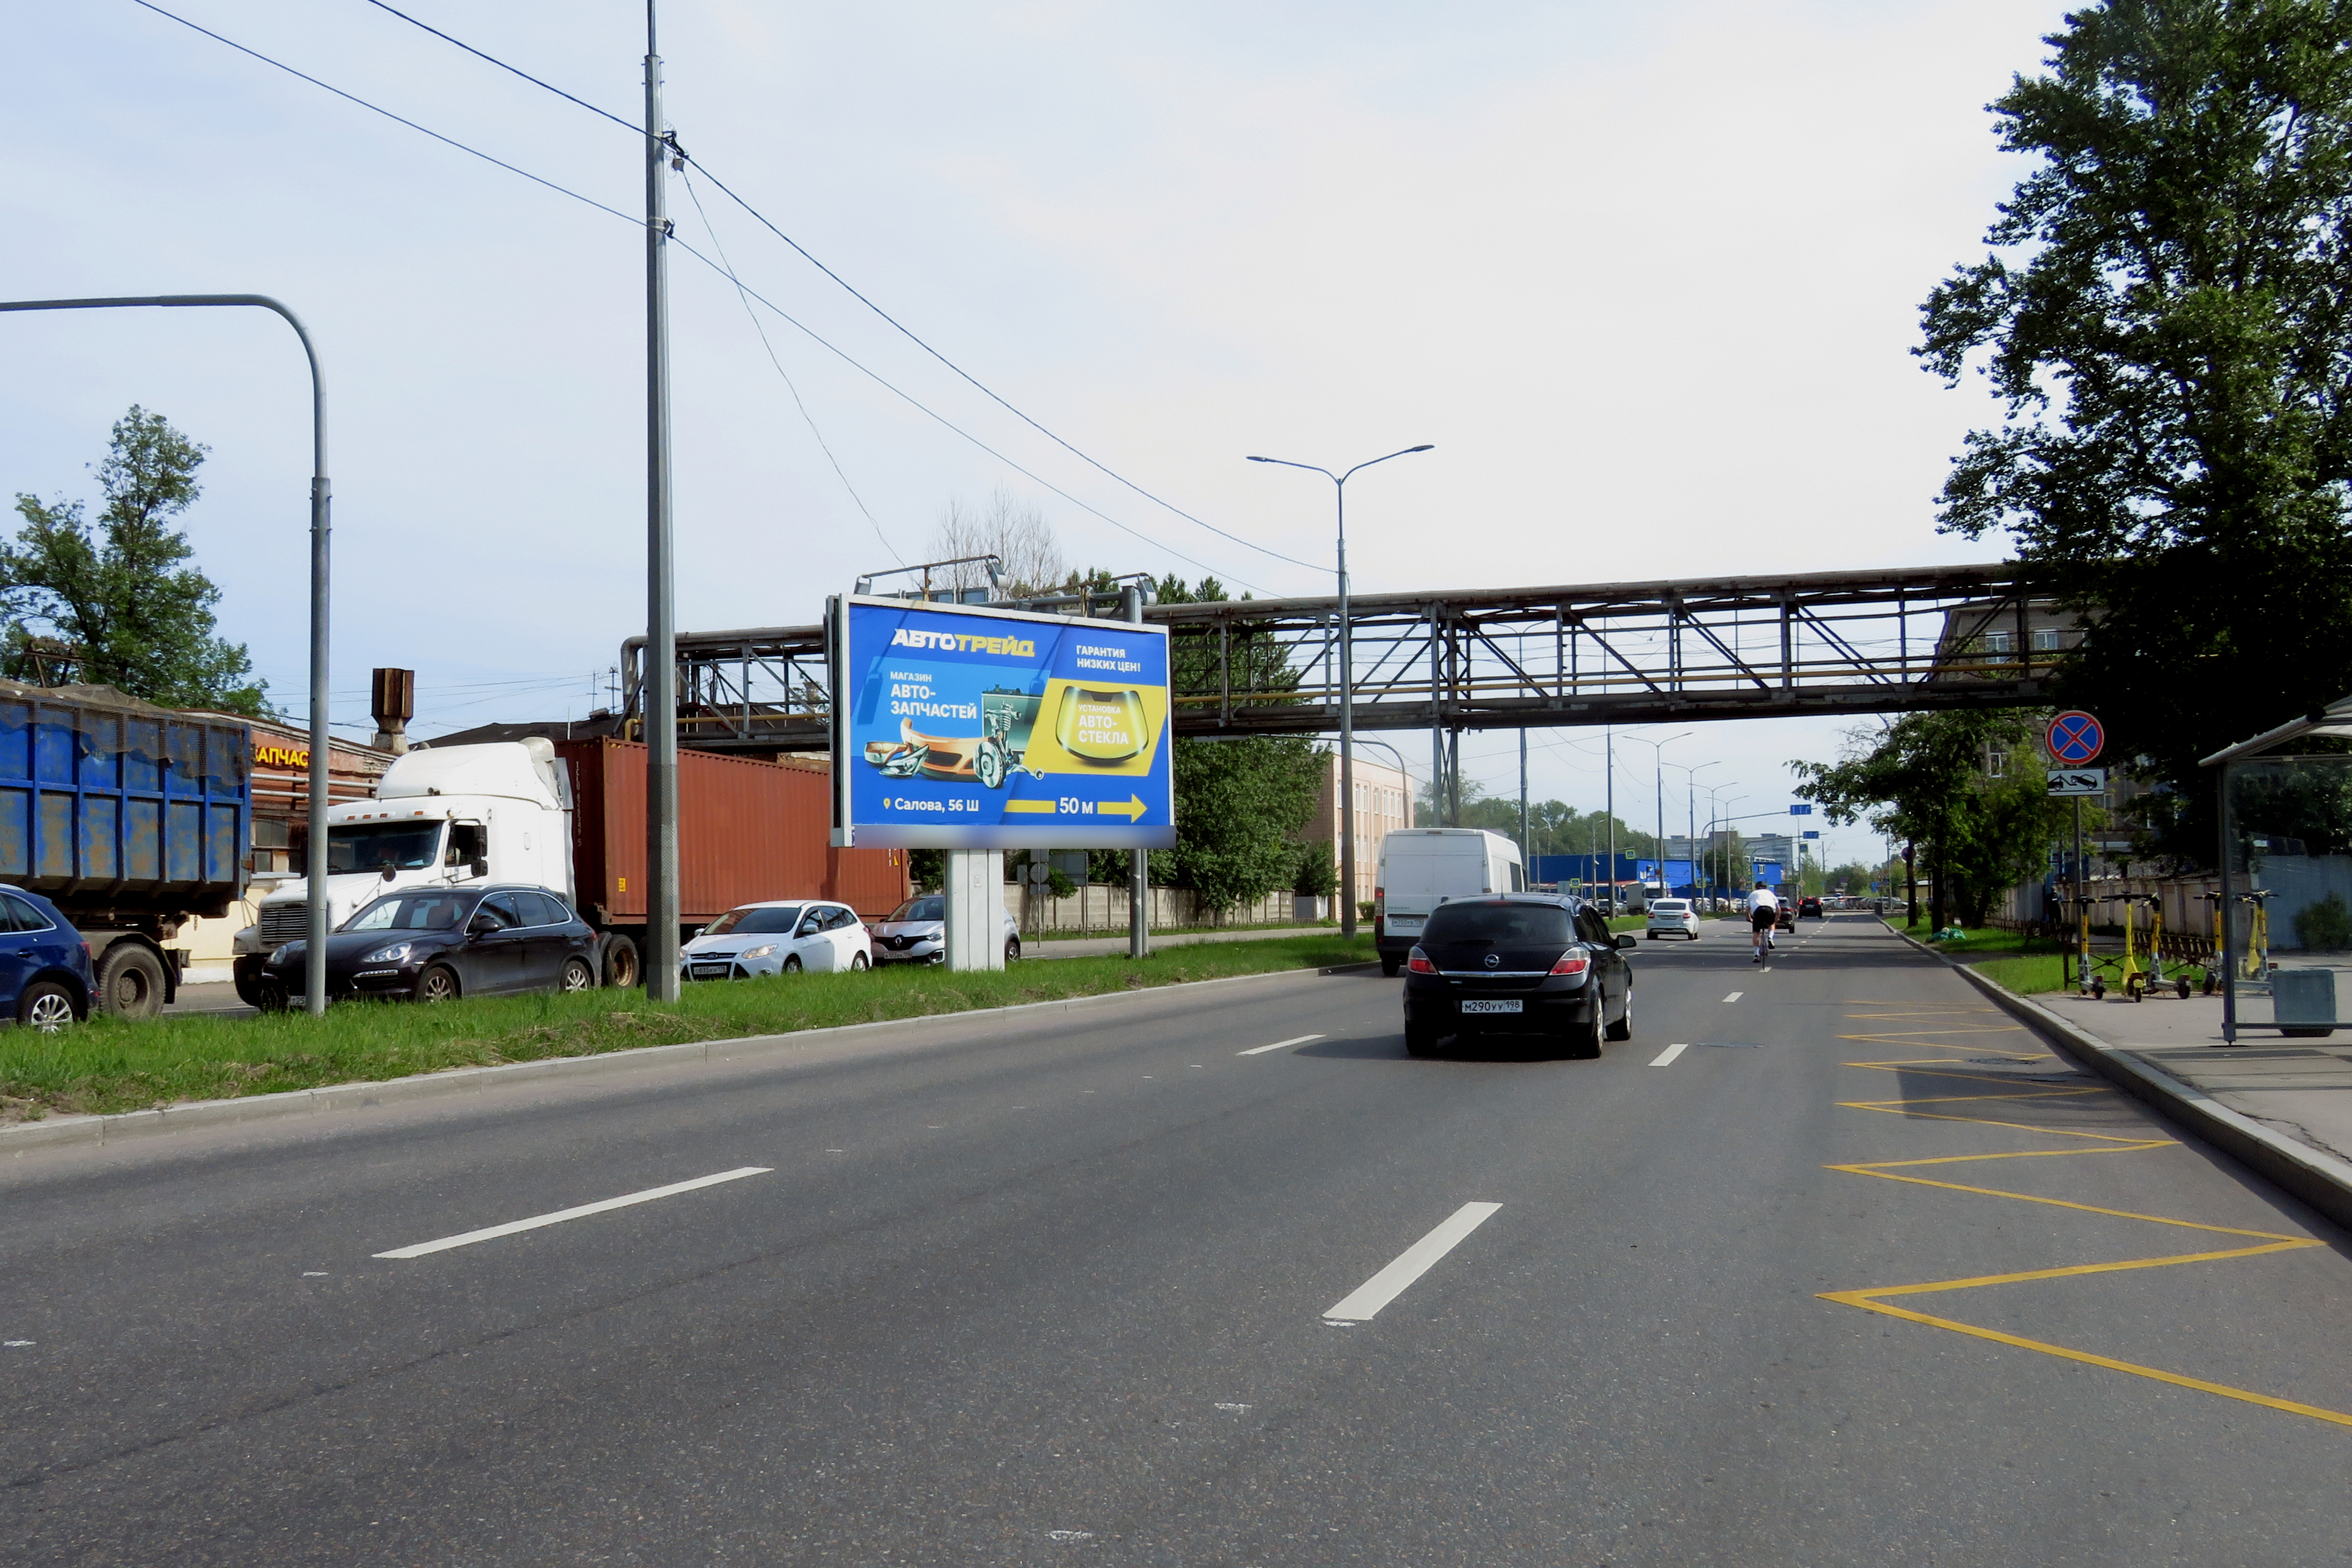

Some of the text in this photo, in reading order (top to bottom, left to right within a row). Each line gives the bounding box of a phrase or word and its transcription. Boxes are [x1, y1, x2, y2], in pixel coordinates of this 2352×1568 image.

[891, 628, 1035, 657] АВТОТРЕЙД
[1076, 645, 1125, 658] ГАРАНТИЯ
[1077, 658, 1141, 673] НИЗКИХ ЦЕН!
[890, 671, 932, 682] МАГАЗИН
[891, 684, 936, 699] АВТО-
[891, 701, 977, 719] ЗАПЧАСТЕЙ
[1078, 704, 1121, 714] УСТАНОВКА
[1079, 715, 1117, 728] АВТО-
[1079, 729, 1129, 744] СТЕКЛА
[256, 747, 309, 767] АПЧАС
[895, 798, 978, 813] Салова, 56 Ш
[1059, 797, 1079, 814] 50
